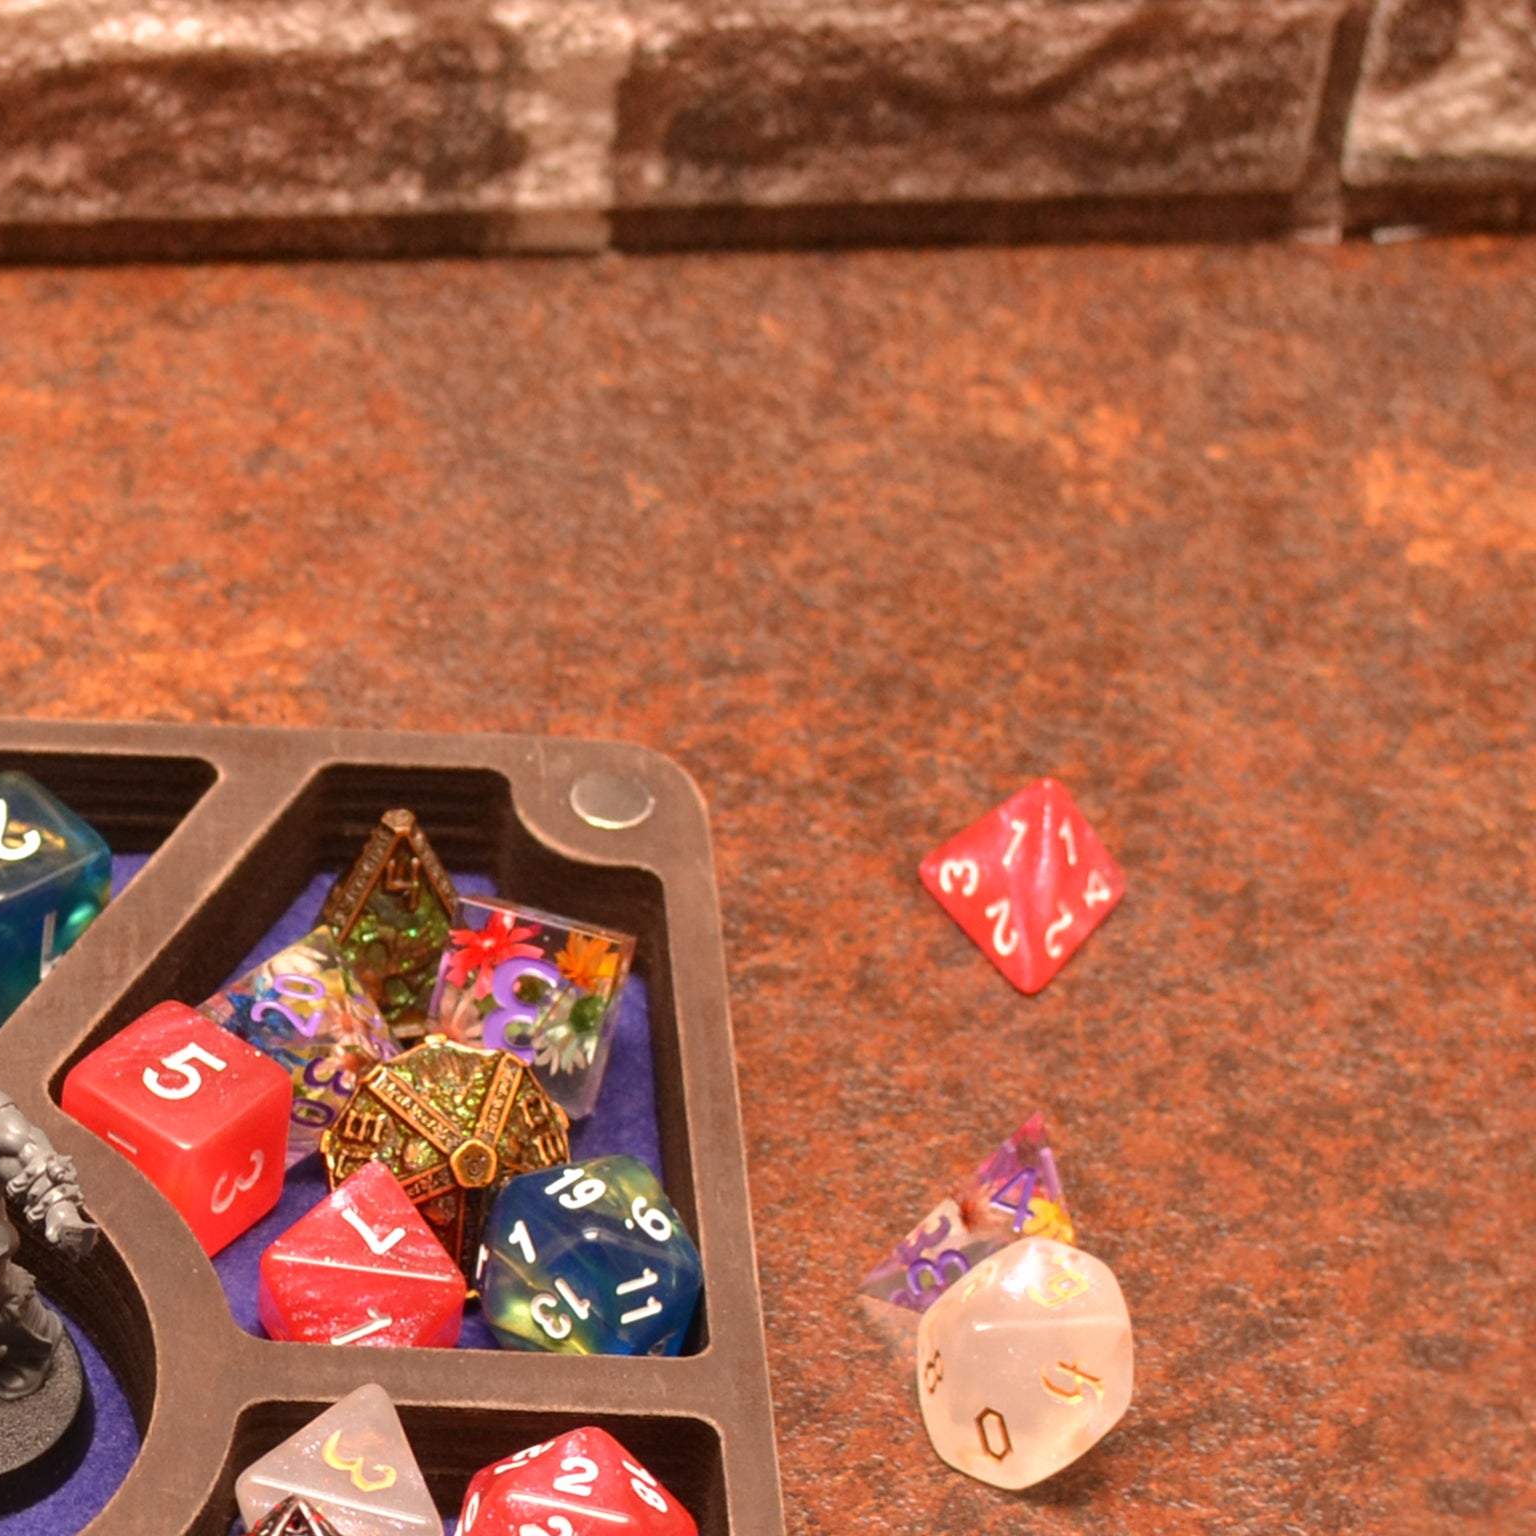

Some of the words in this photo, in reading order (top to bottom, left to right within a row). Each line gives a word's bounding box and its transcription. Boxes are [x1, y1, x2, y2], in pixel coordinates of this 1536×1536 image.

[1002, 820, 1027, 867] 1
[1058, 817, 1078, 867] 1
[938, 859, 979, 897] 3
[984, 900, 1019, 957] 2
[250, 972, 327, 1038] 20
[141, 1041, 228, 1101] 5
[211, 1149, 265, 1214] 3
[544, 1167, 607, 1210] 19
[530, 1276, 592, 1340] 13
[615, 1267, 664, 1326] 11
[321, 1429, 398, 1493] 3
[552, 1456, 600, 1497] 2
[621, 1459, 669, 1514] 18
